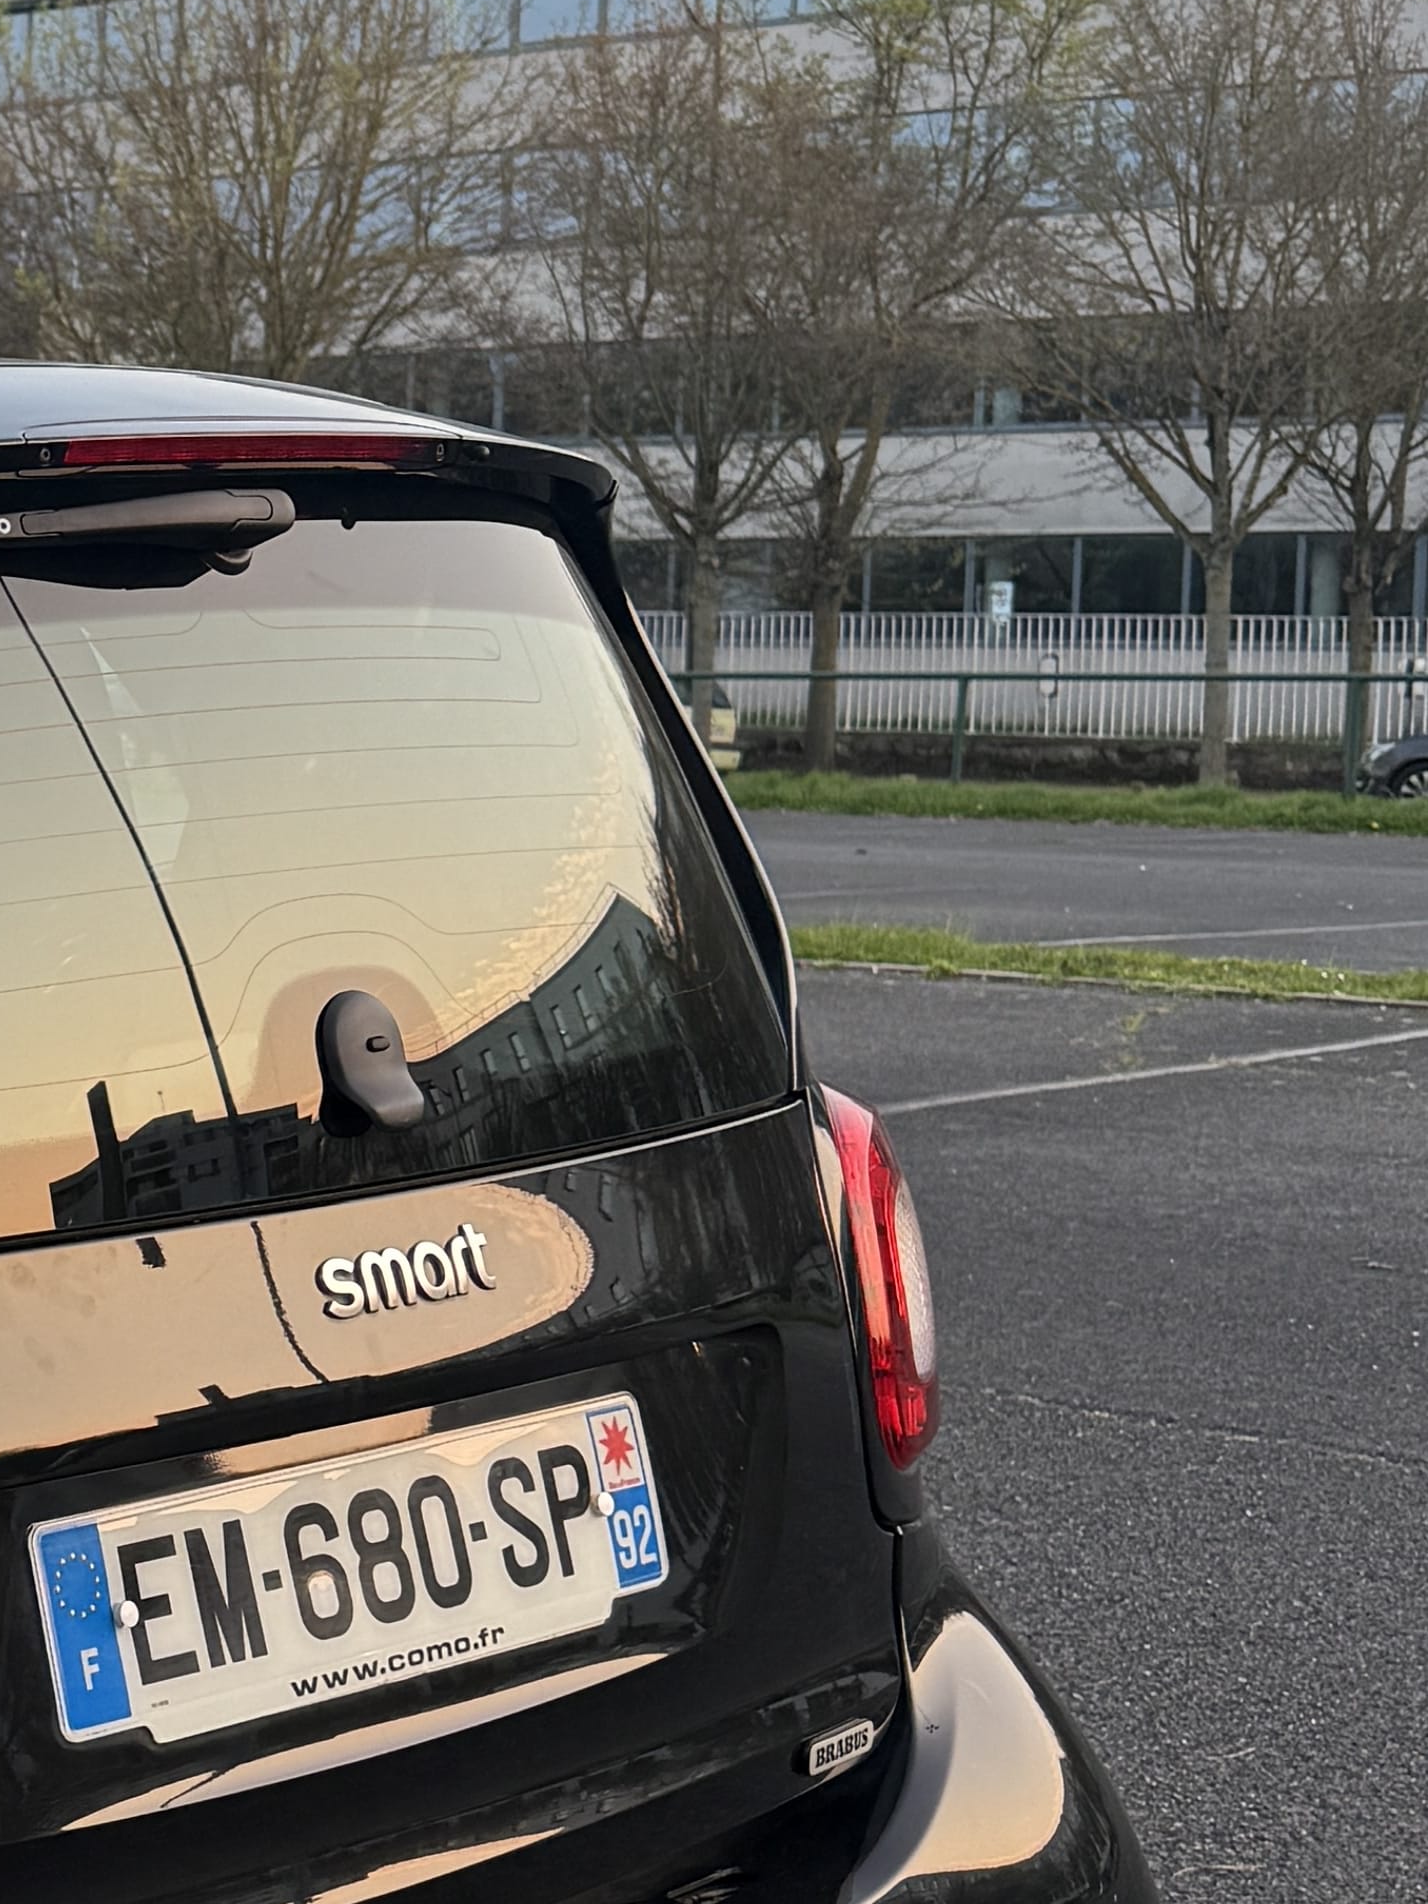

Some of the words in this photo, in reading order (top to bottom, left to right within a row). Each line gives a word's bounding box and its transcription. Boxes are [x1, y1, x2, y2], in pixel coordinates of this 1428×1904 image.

[315, 1223, 496, 1320] smart
[117, 1445, 591, 1686] EM-680-SP
[613, 1504, 658, 1569] 92
[80, 1647, 100, 1691] F
[290, 1626, 505, 1697] www.como.fr
[815, 1728, 869, 1768] BRABUS
